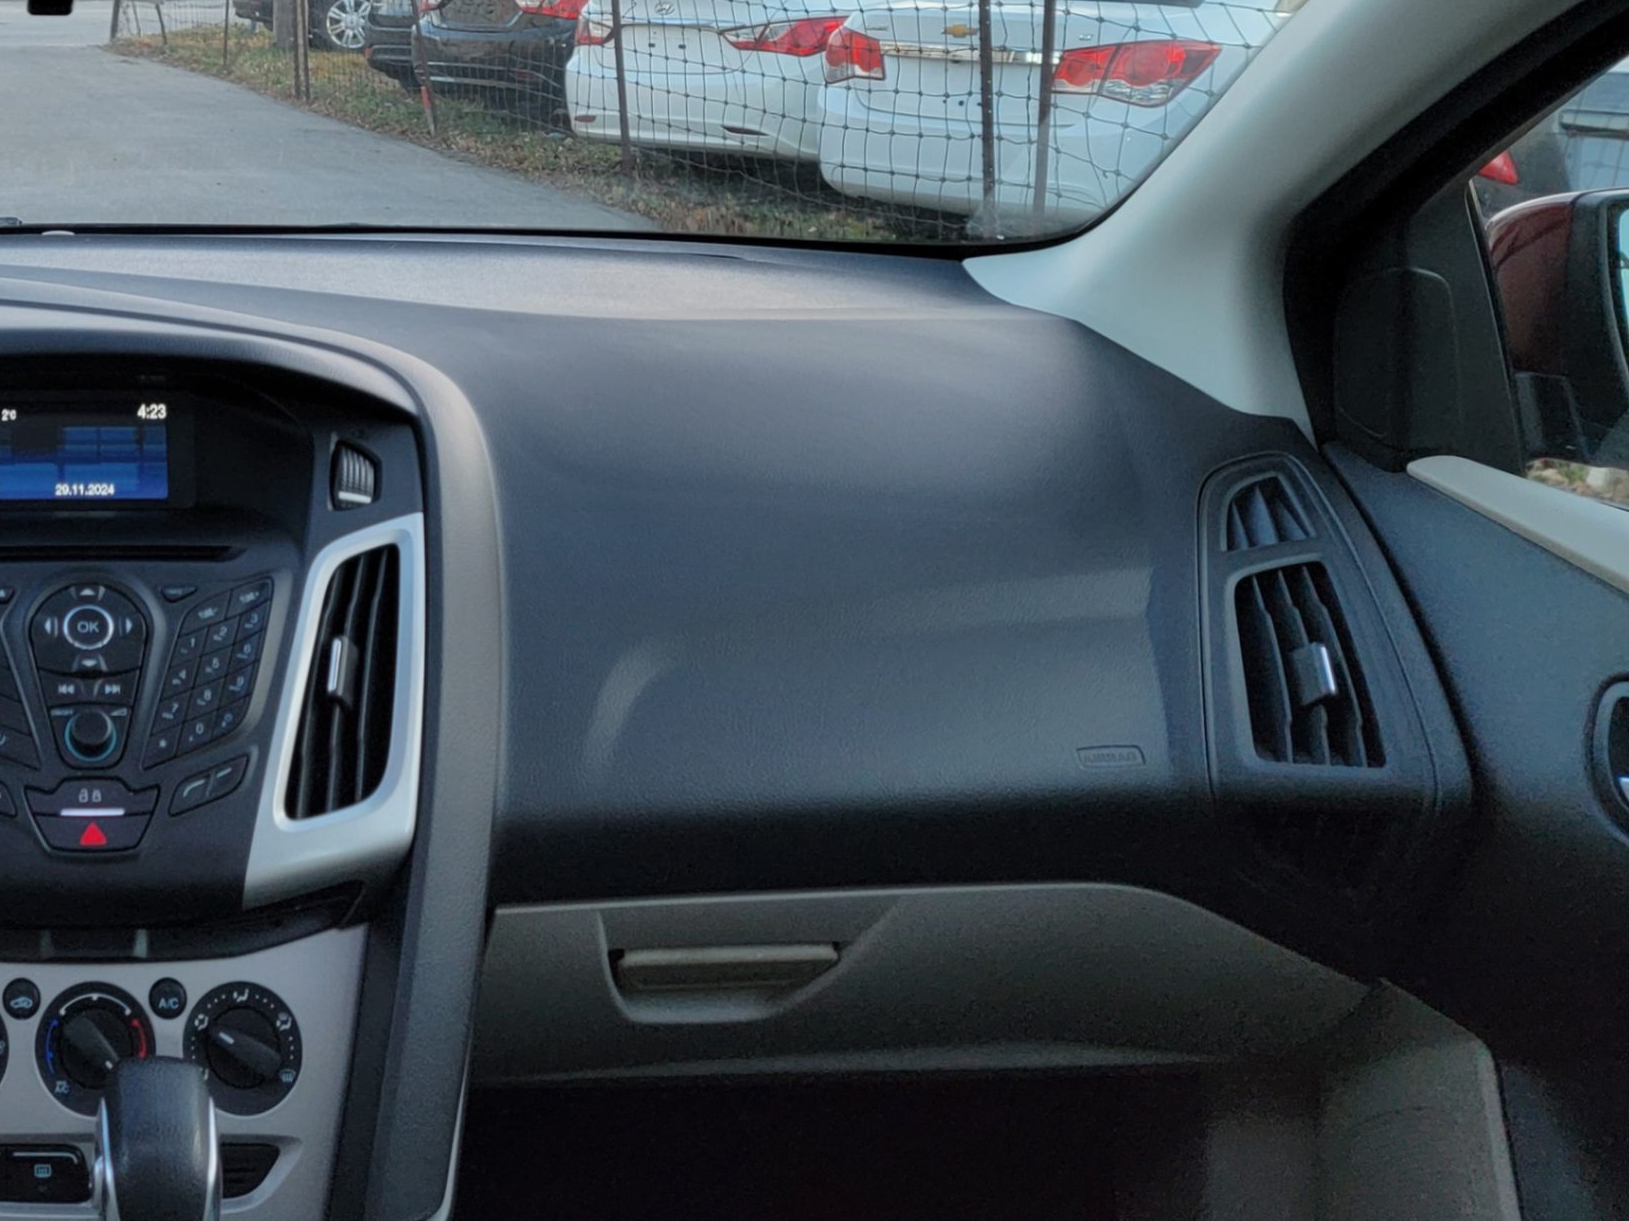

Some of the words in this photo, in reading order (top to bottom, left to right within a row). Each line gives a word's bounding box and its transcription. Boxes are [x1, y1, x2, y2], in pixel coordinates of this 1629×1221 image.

[137, 404, 167, 420] 4:23
[77, 620, 100, 633] OK
[158, 997, 180, 1010] A/C
